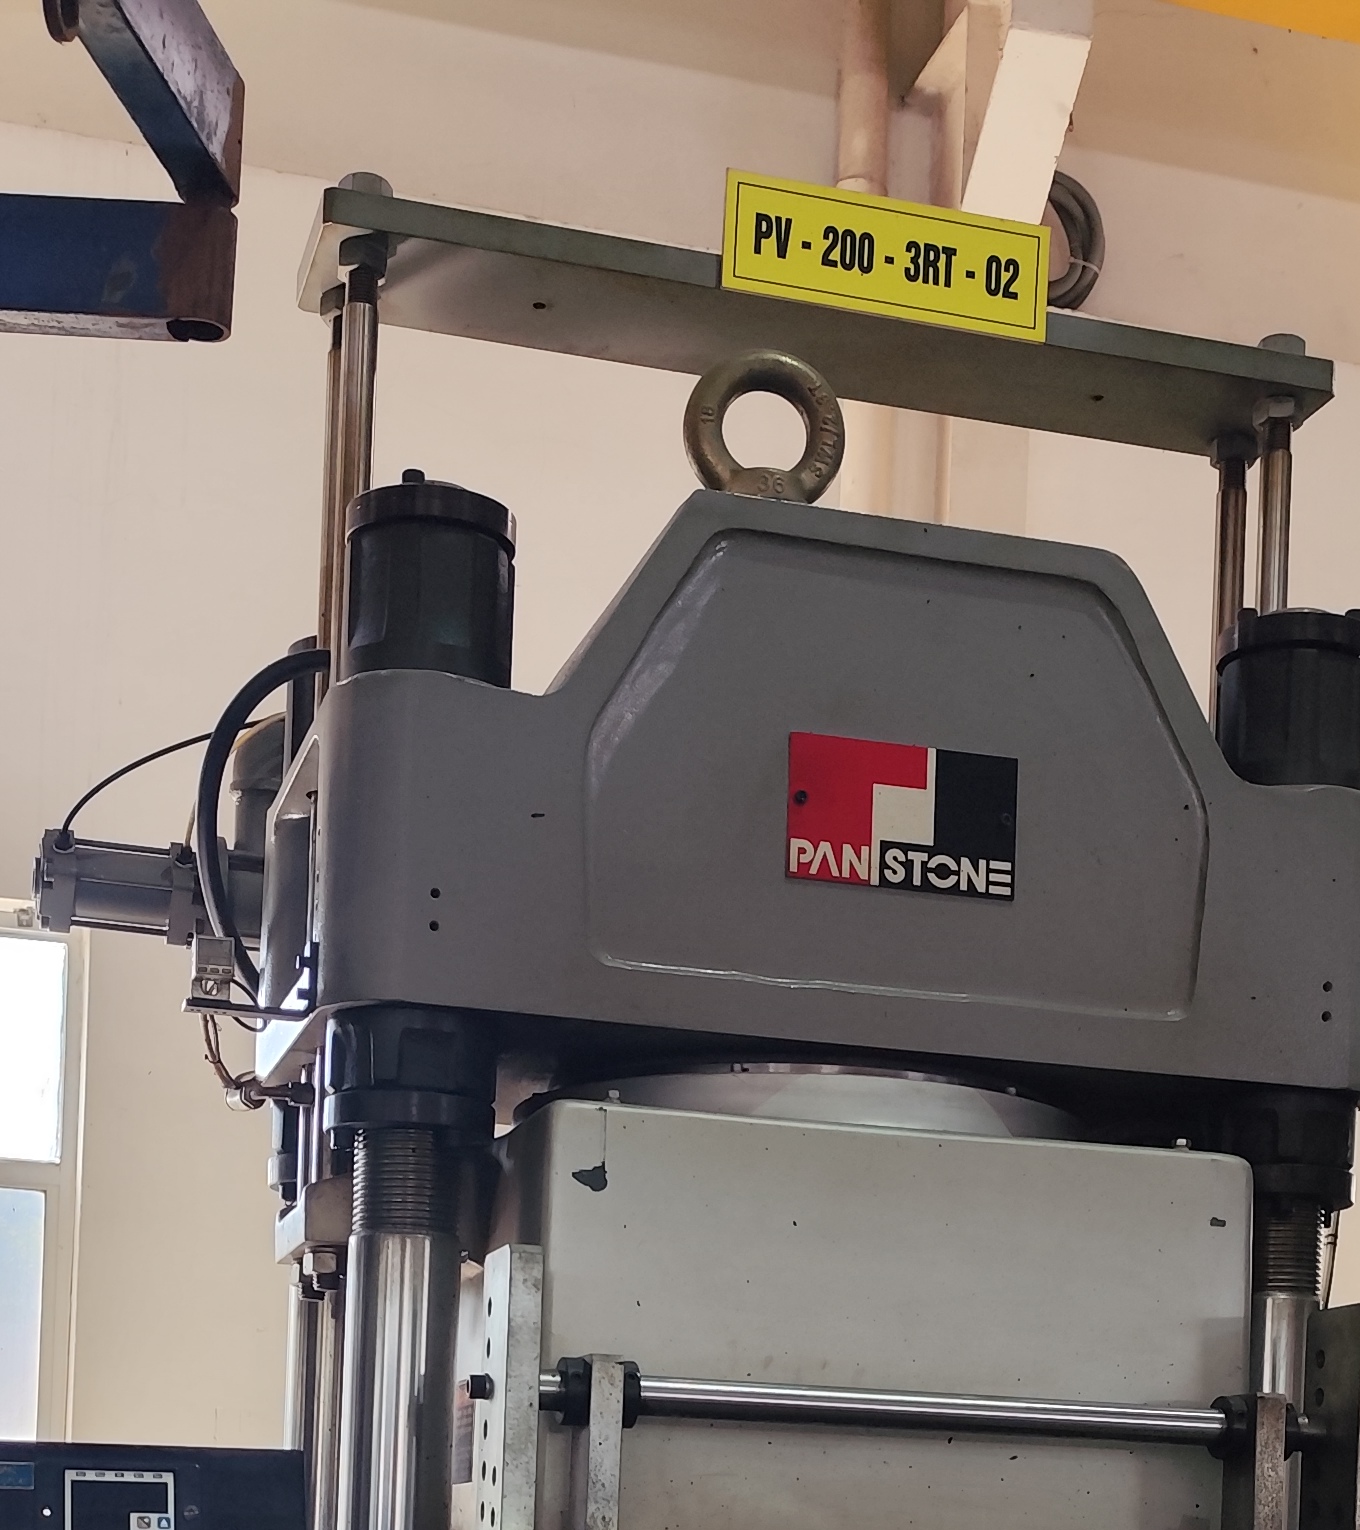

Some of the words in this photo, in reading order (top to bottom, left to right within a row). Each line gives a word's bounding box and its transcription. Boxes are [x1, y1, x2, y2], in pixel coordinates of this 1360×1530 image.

[754, 212, 792, 259] PV
[821, 226, 875, 273] 200
[904, 241, 957, 288] 3RT
[985, 255, 1020, 300] 02
[758, 475, 785, 494] 36
